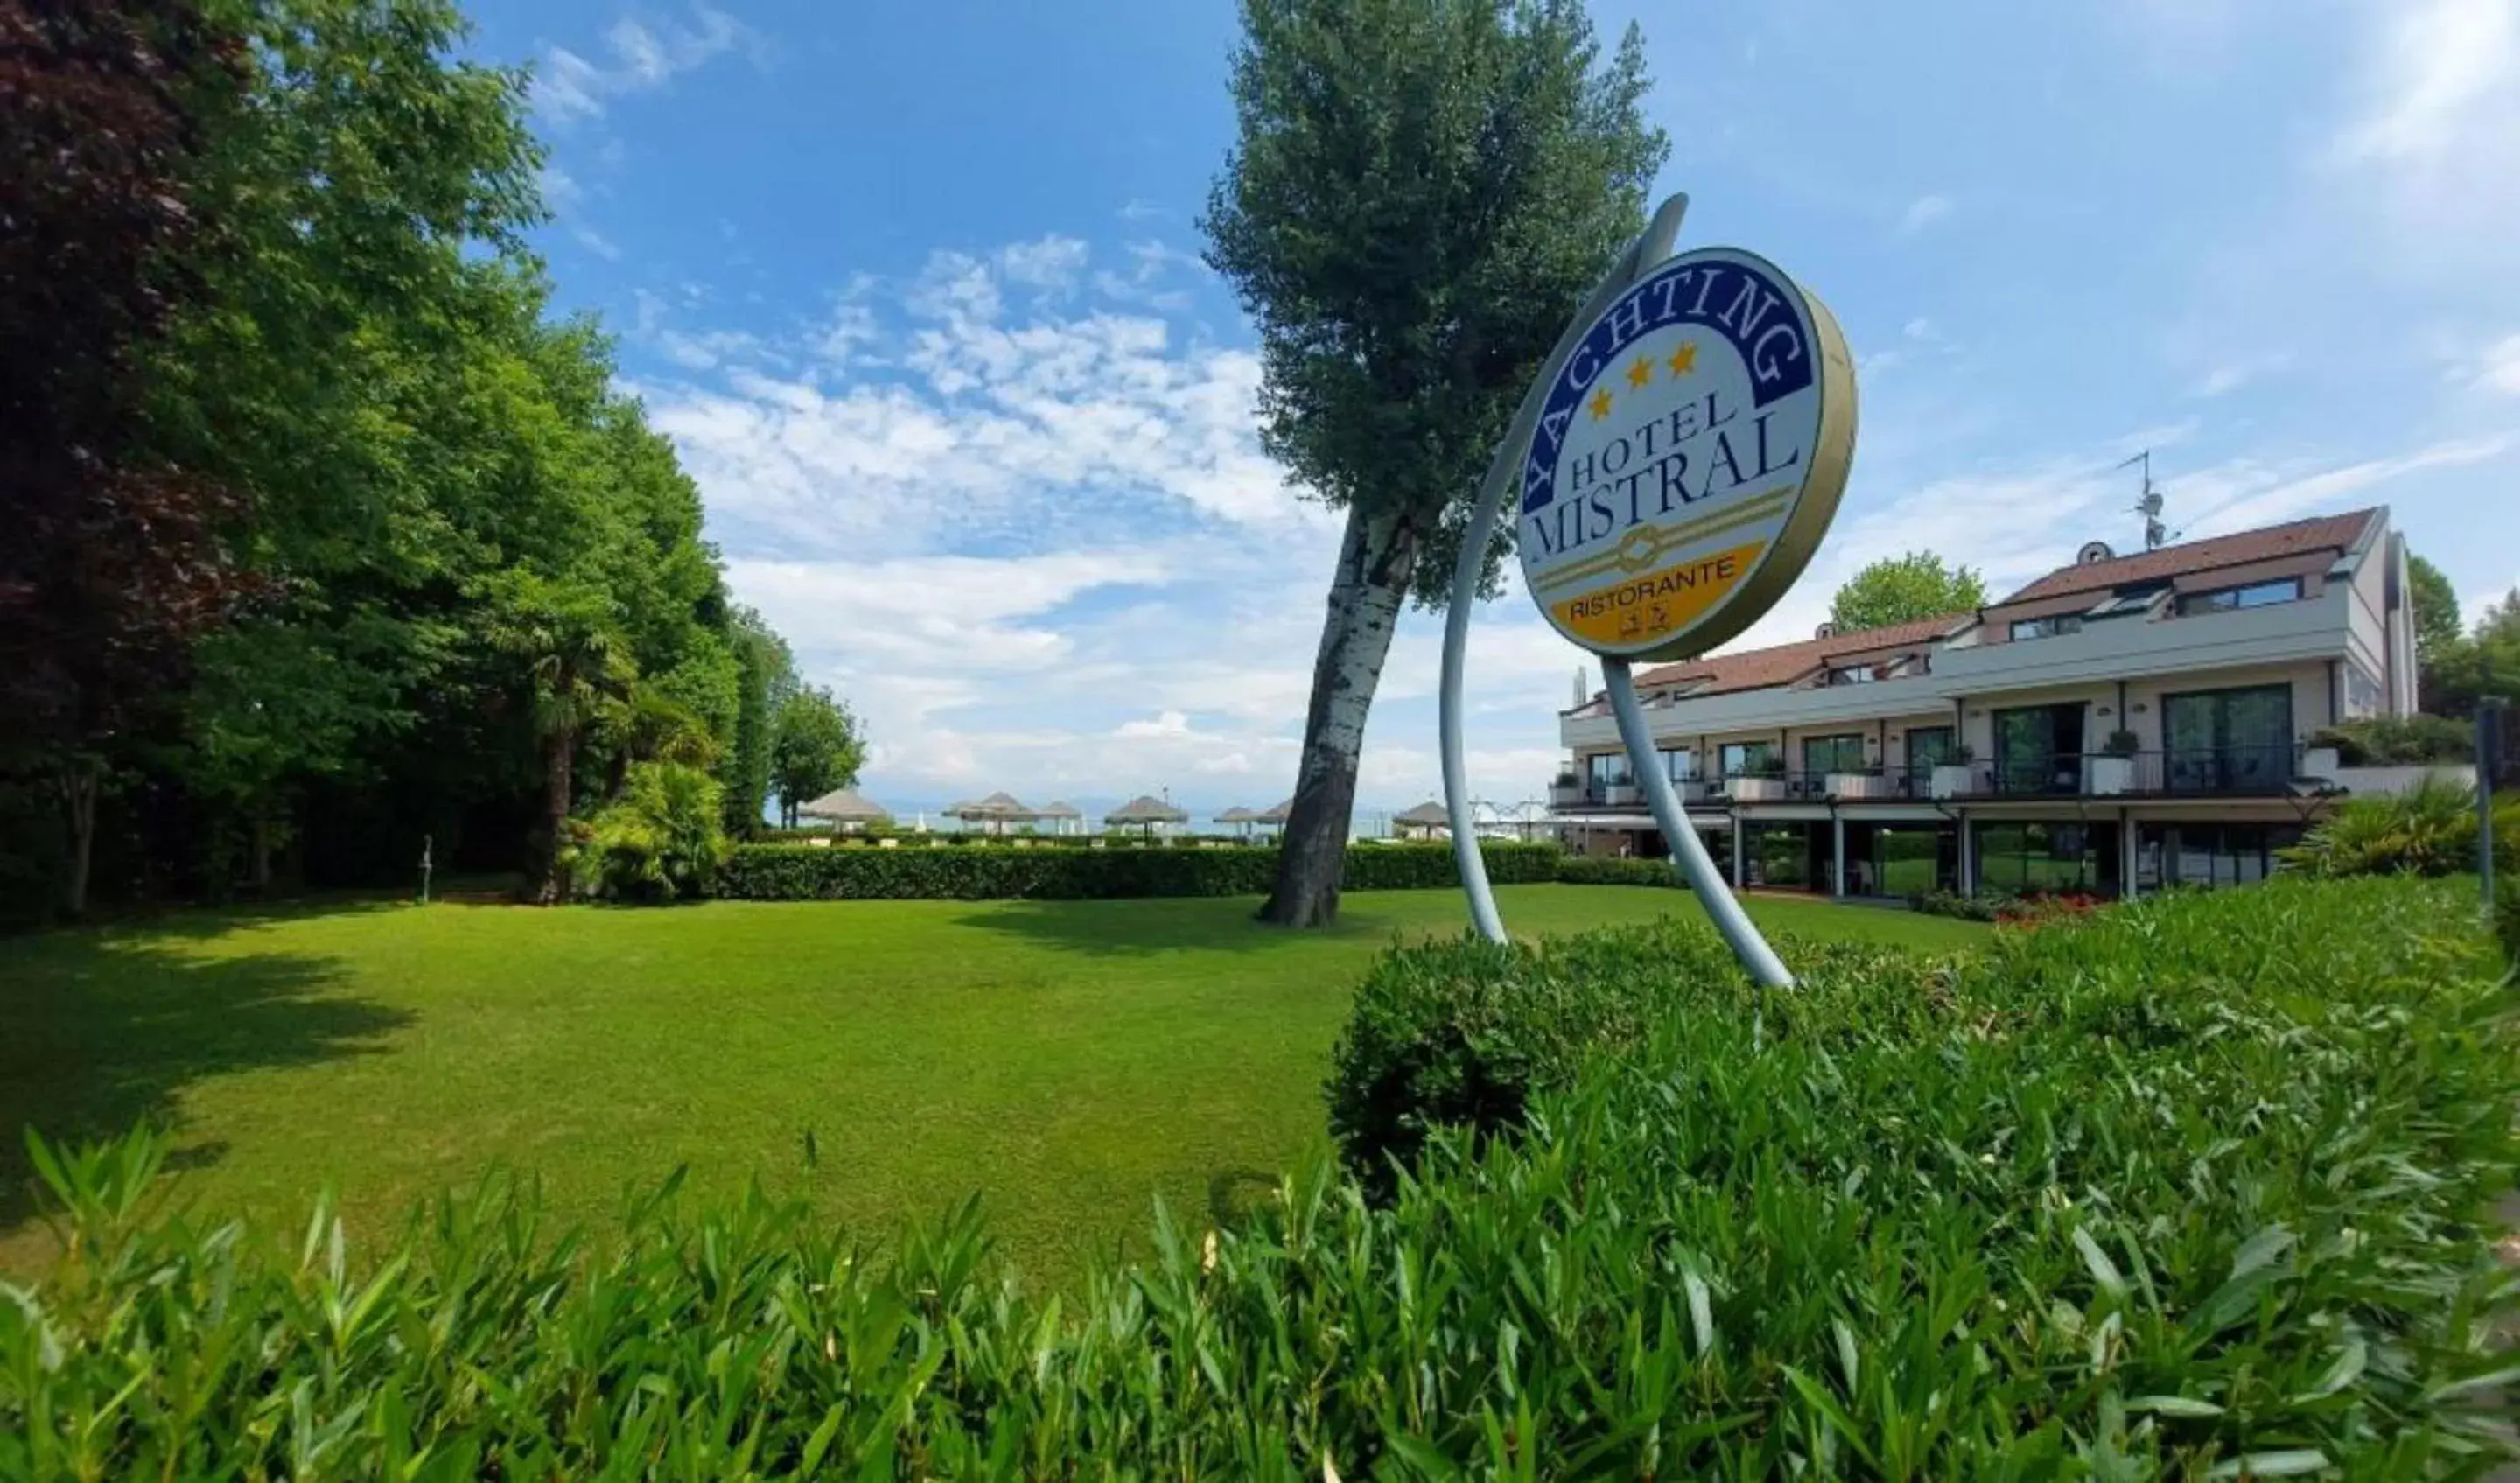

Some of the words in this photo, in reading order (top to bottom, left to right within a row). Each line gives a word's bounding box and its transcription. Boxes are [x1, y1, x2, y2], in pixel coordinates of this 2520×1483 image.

[1524, 269, 1802, 499] YACHTING
[1572, 390, 1738, 492] HOTEL
[1530, 411, 1799, 564] MISTRAL
[1569, 556, 1736, 622] RISTORANTE
